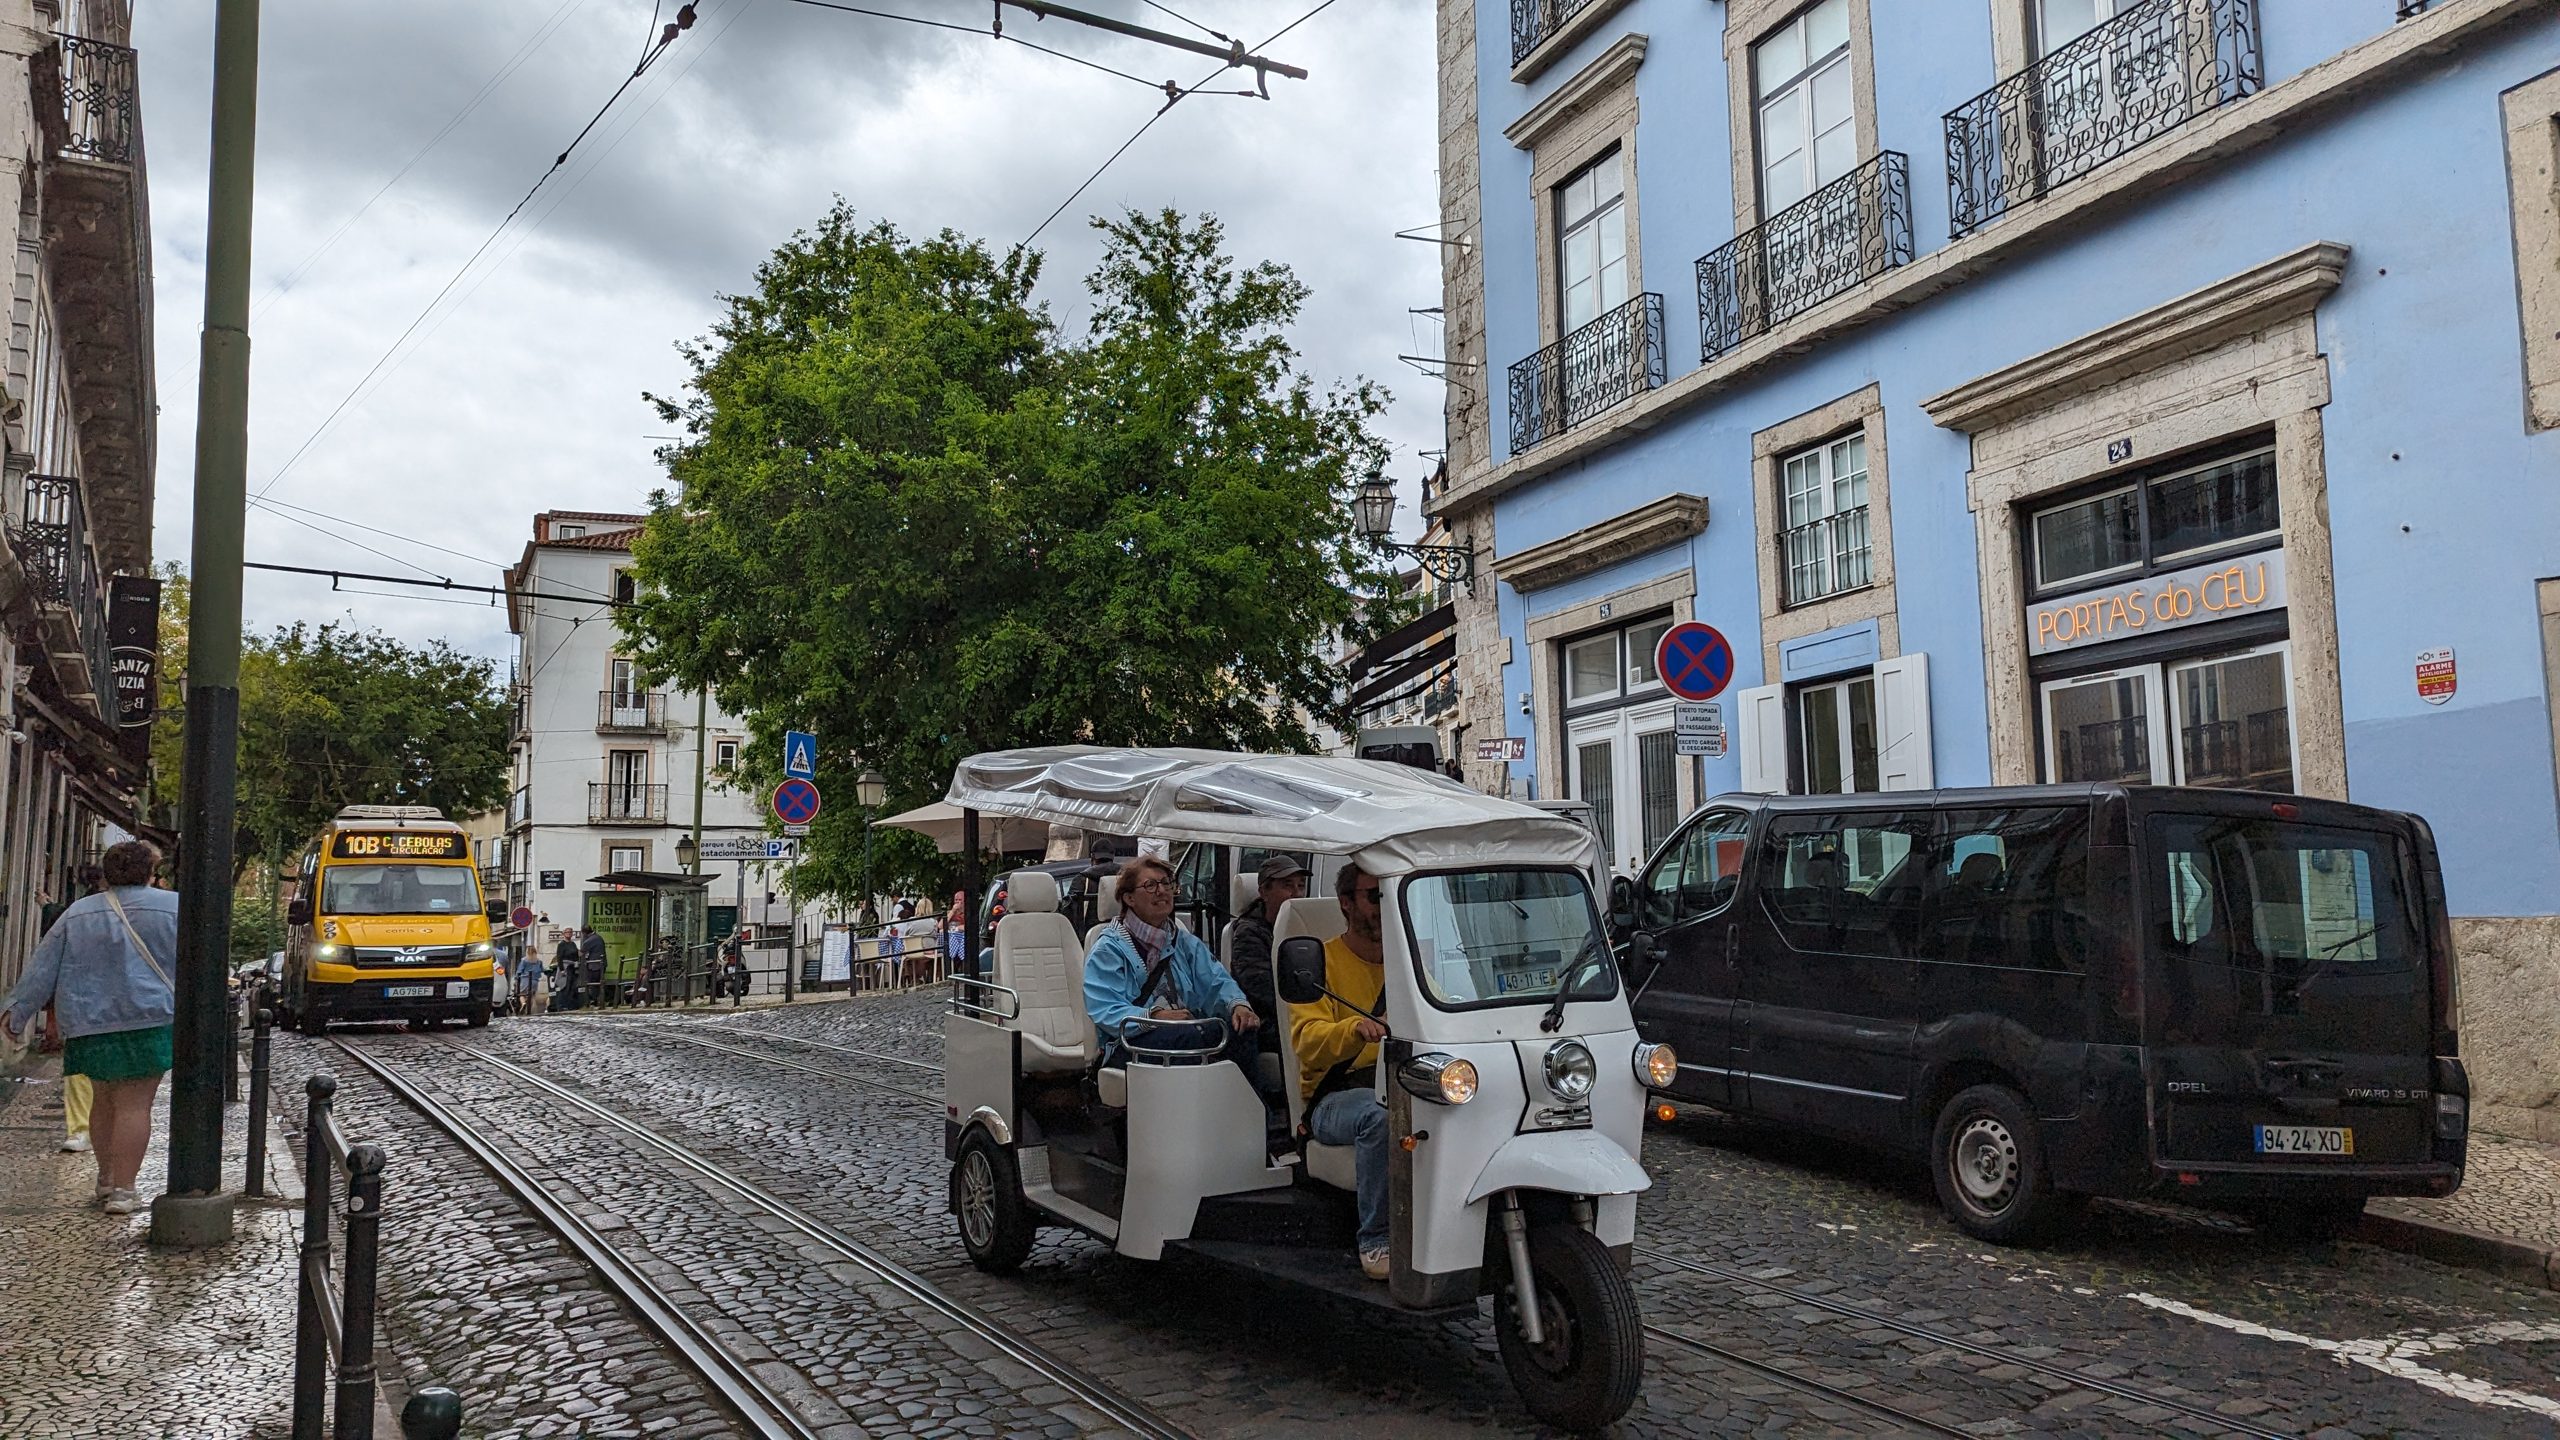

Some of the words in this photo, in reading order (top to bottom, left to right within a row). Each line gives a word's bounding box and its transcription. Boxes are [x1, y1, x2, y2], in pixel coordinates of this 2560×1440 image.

[2111, 440, 2128, 460] 24
[1600, 604, 1610, 617] 26
[2038, 592, 2146, 646] PORTAS
[2155, 582, 2194, 621] do
[2201, 563, 2266, 611] CÉU
[2417, 652, 2435, 661] NOS
[2419, 661, 2453, 673] ALARME
[113, 676, 145, 689] UZIA
[345, 836, 380, 855] 10B
[382, 836, 395, 848] C.
[398, 836, 453, 848] CEBOLAS
[700, 841, 725, 849] parque
[768, 842, 780, 856] P
[592, 902, 642, 916] LISBOA
[393, 955, 427, 963] MAN
[458, 985, 469, 994] TP
[2168, 1082, 2211, 1093] OPEL
[2346, 1087, 2390, 1099] VIVARO
